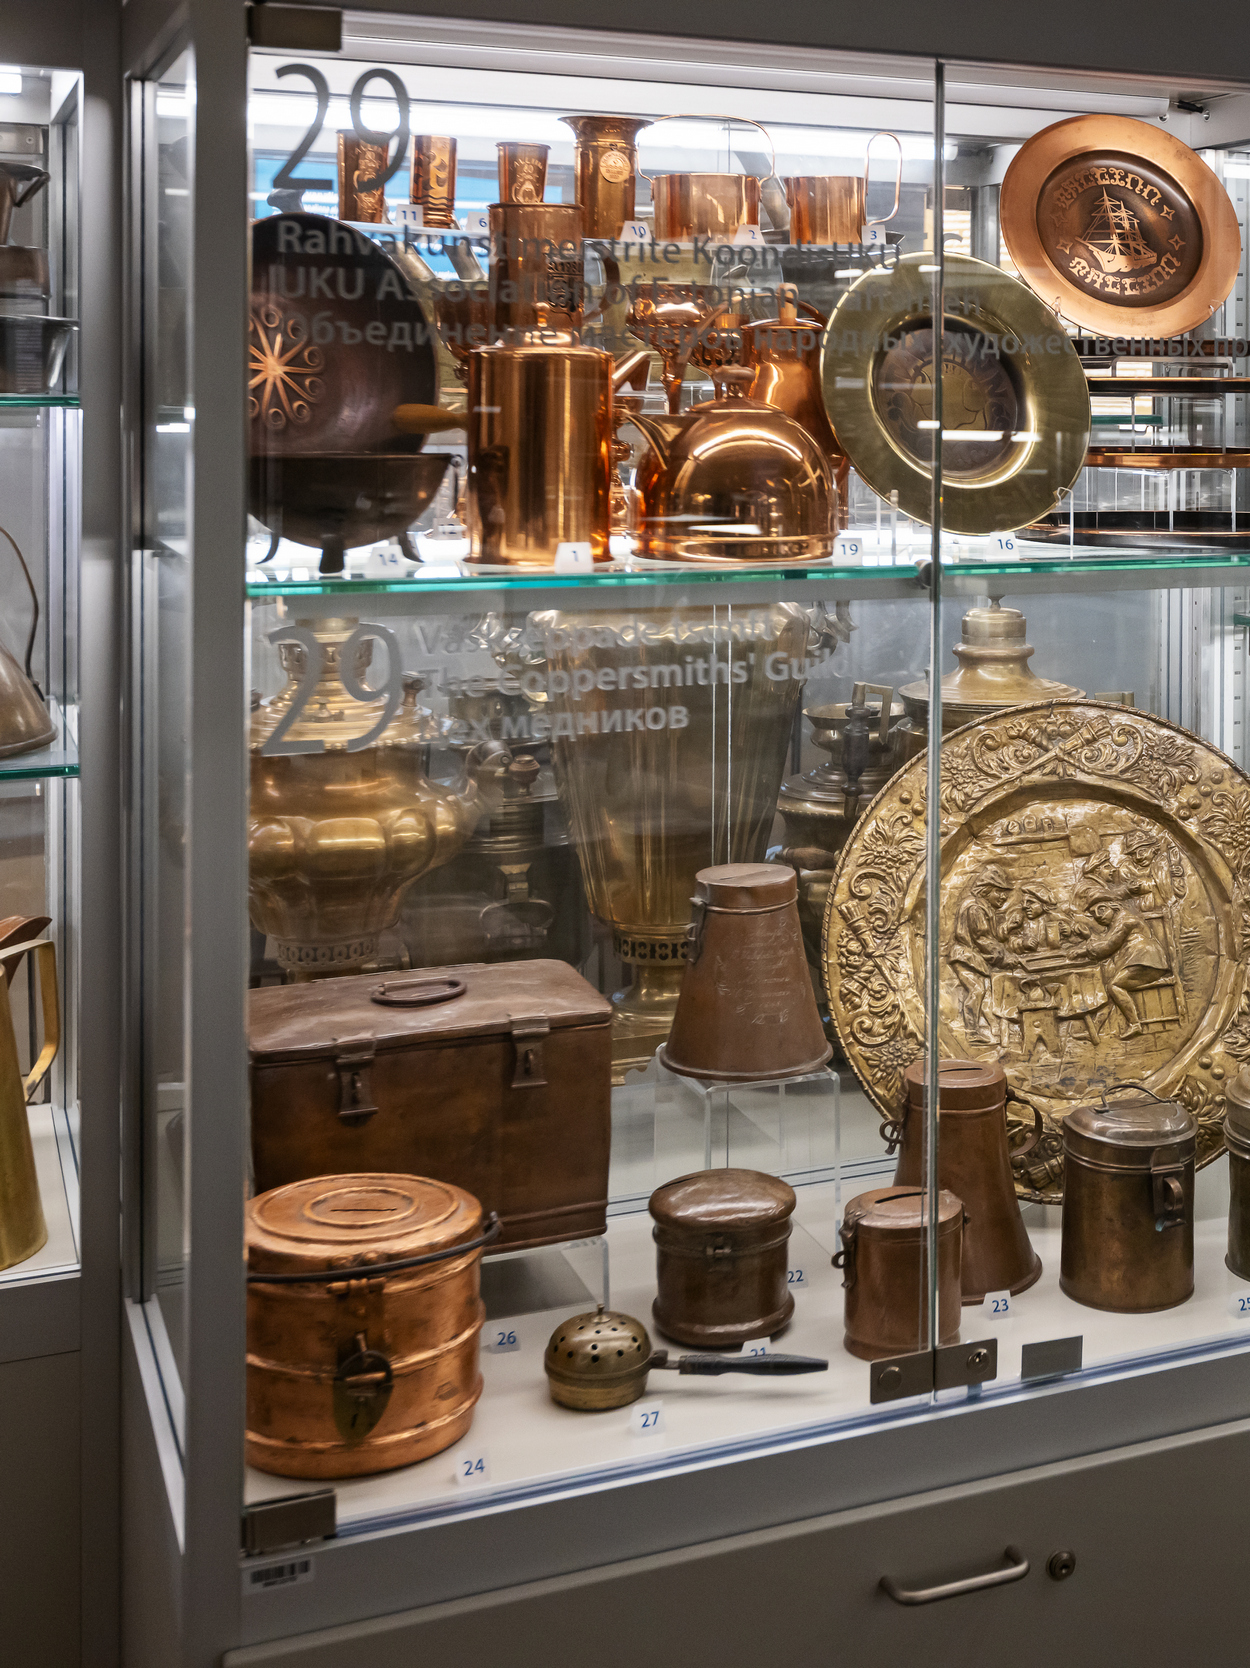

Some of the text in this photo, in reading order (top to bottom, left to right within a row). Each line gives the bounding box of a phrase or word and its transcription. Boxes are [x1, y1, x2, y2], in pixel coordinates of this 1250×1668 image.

[272, 63, 410, 193] 29
[401, 210, 417, 221] 11
[478, 217, 488, 228] 6
[748, 229, 756, 241] 2
[869, 230, 878, 240] 3
[605, 274, 642, 306] of
[840, 543, 858, 556] 19
[997, 538, 1014, 551] 16
[377, 553, 399, 566] 14
[571, 550, 580, 562] 1
[260, 621, 402, 757] 29
[502, 704, 690, 744] медников
[787, 1269, 805, 1284] 22
[991, 1298, 1009, 1313] 23
[496, 1330, 517, 1347] 26
[640, 1410, 660, 1429] 27
[462, 1457, 486, 1477] 24
